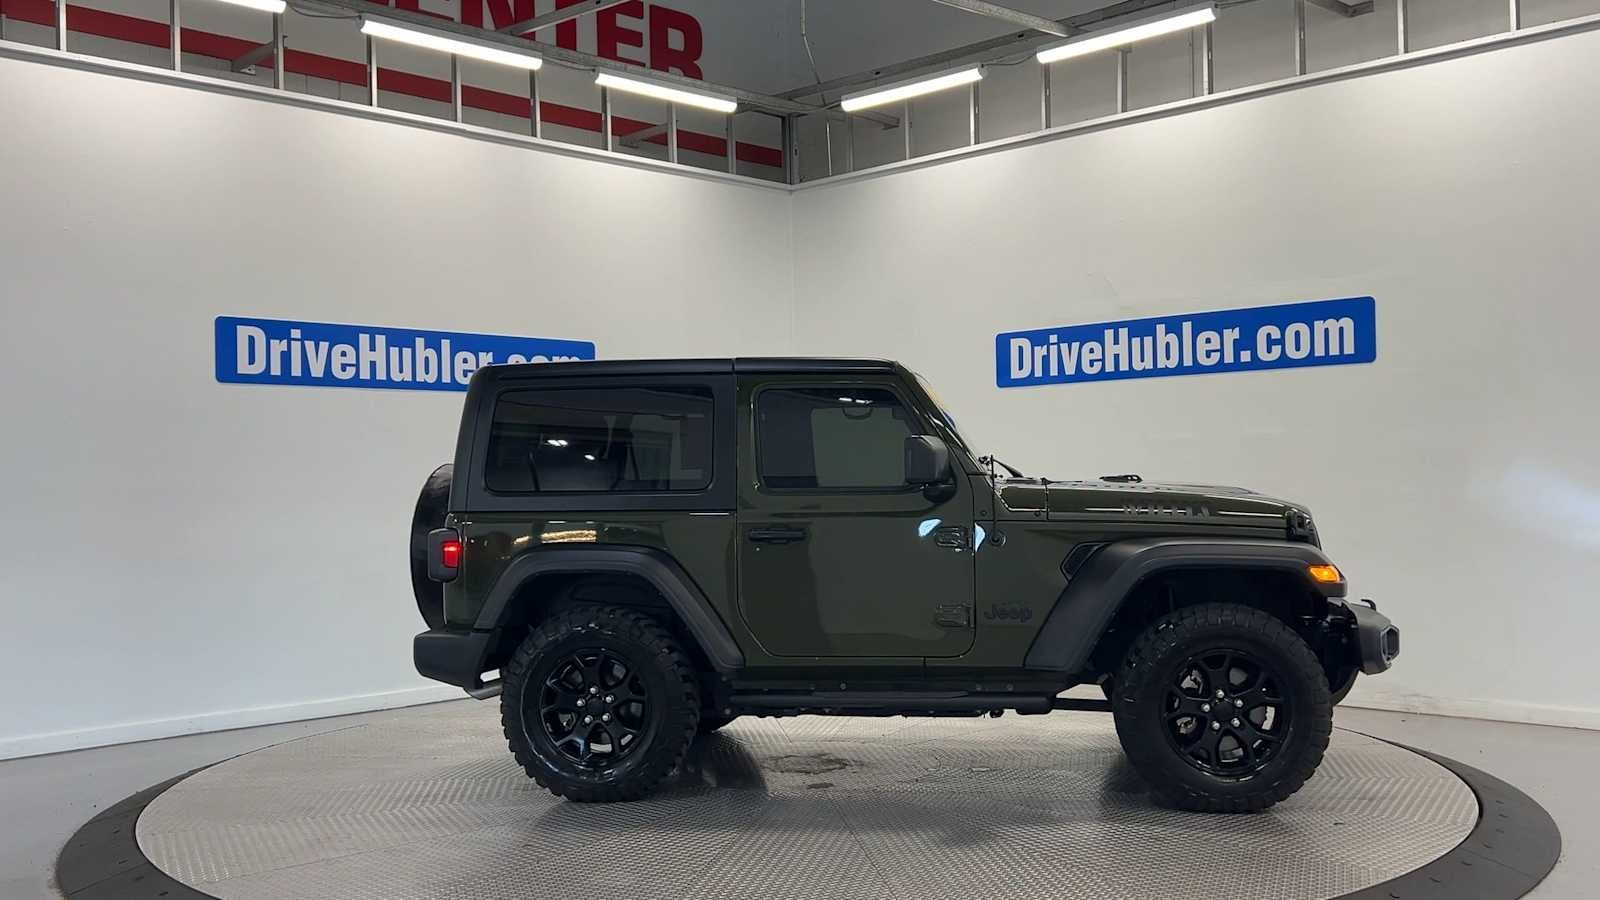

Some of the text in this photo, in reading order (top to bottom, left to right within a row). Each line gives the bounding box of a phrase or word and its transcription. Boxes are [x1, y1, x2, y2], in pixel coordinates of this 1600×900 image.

[363, 0, 703, 80] NTER
[236, 325, 581, 384] DriveHubler
[1010, 316, 1356, 380] DriveHubler.com
[983, 605, 1033, 624] Jeep
